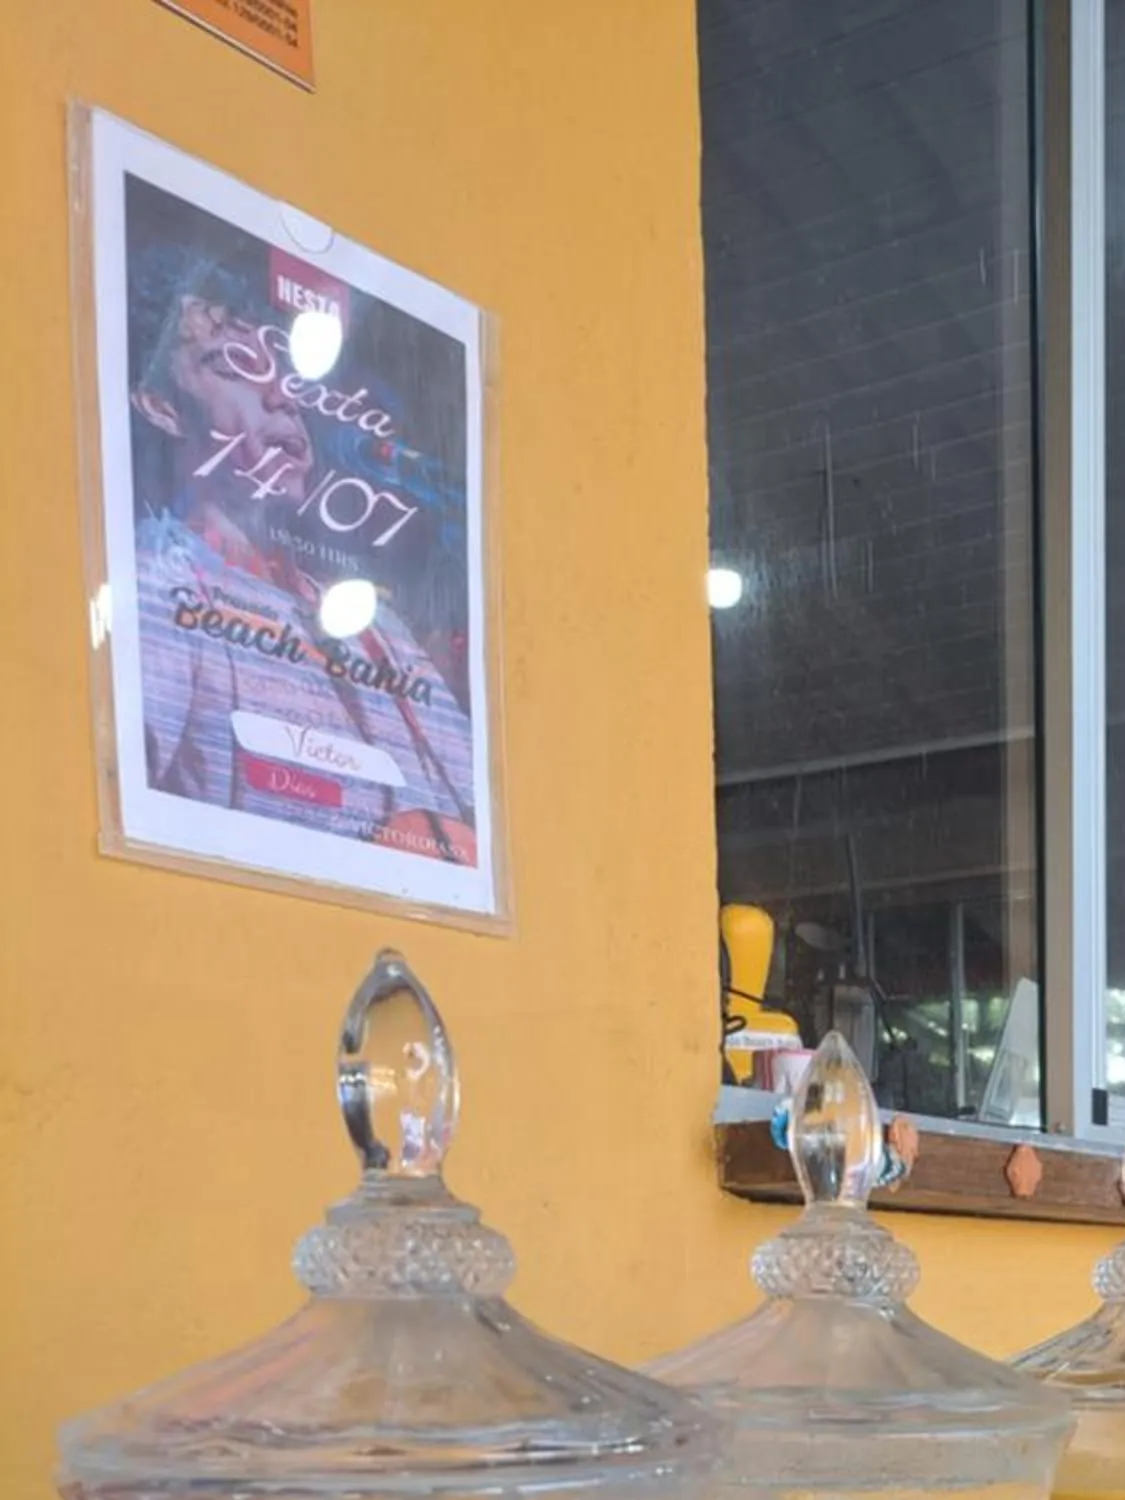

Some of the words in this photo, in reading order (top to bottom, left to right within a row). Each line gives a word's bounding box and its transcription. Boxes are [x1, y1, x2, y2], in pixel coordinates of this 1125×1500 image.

[222, 323, 396, 438] Sexta
[192, 429, 419, 547] 14/07
[170, 586, 306, 664] Beach
[315, 637, 432, 707] Bahia
[284, 720, 362, 771] Victor
